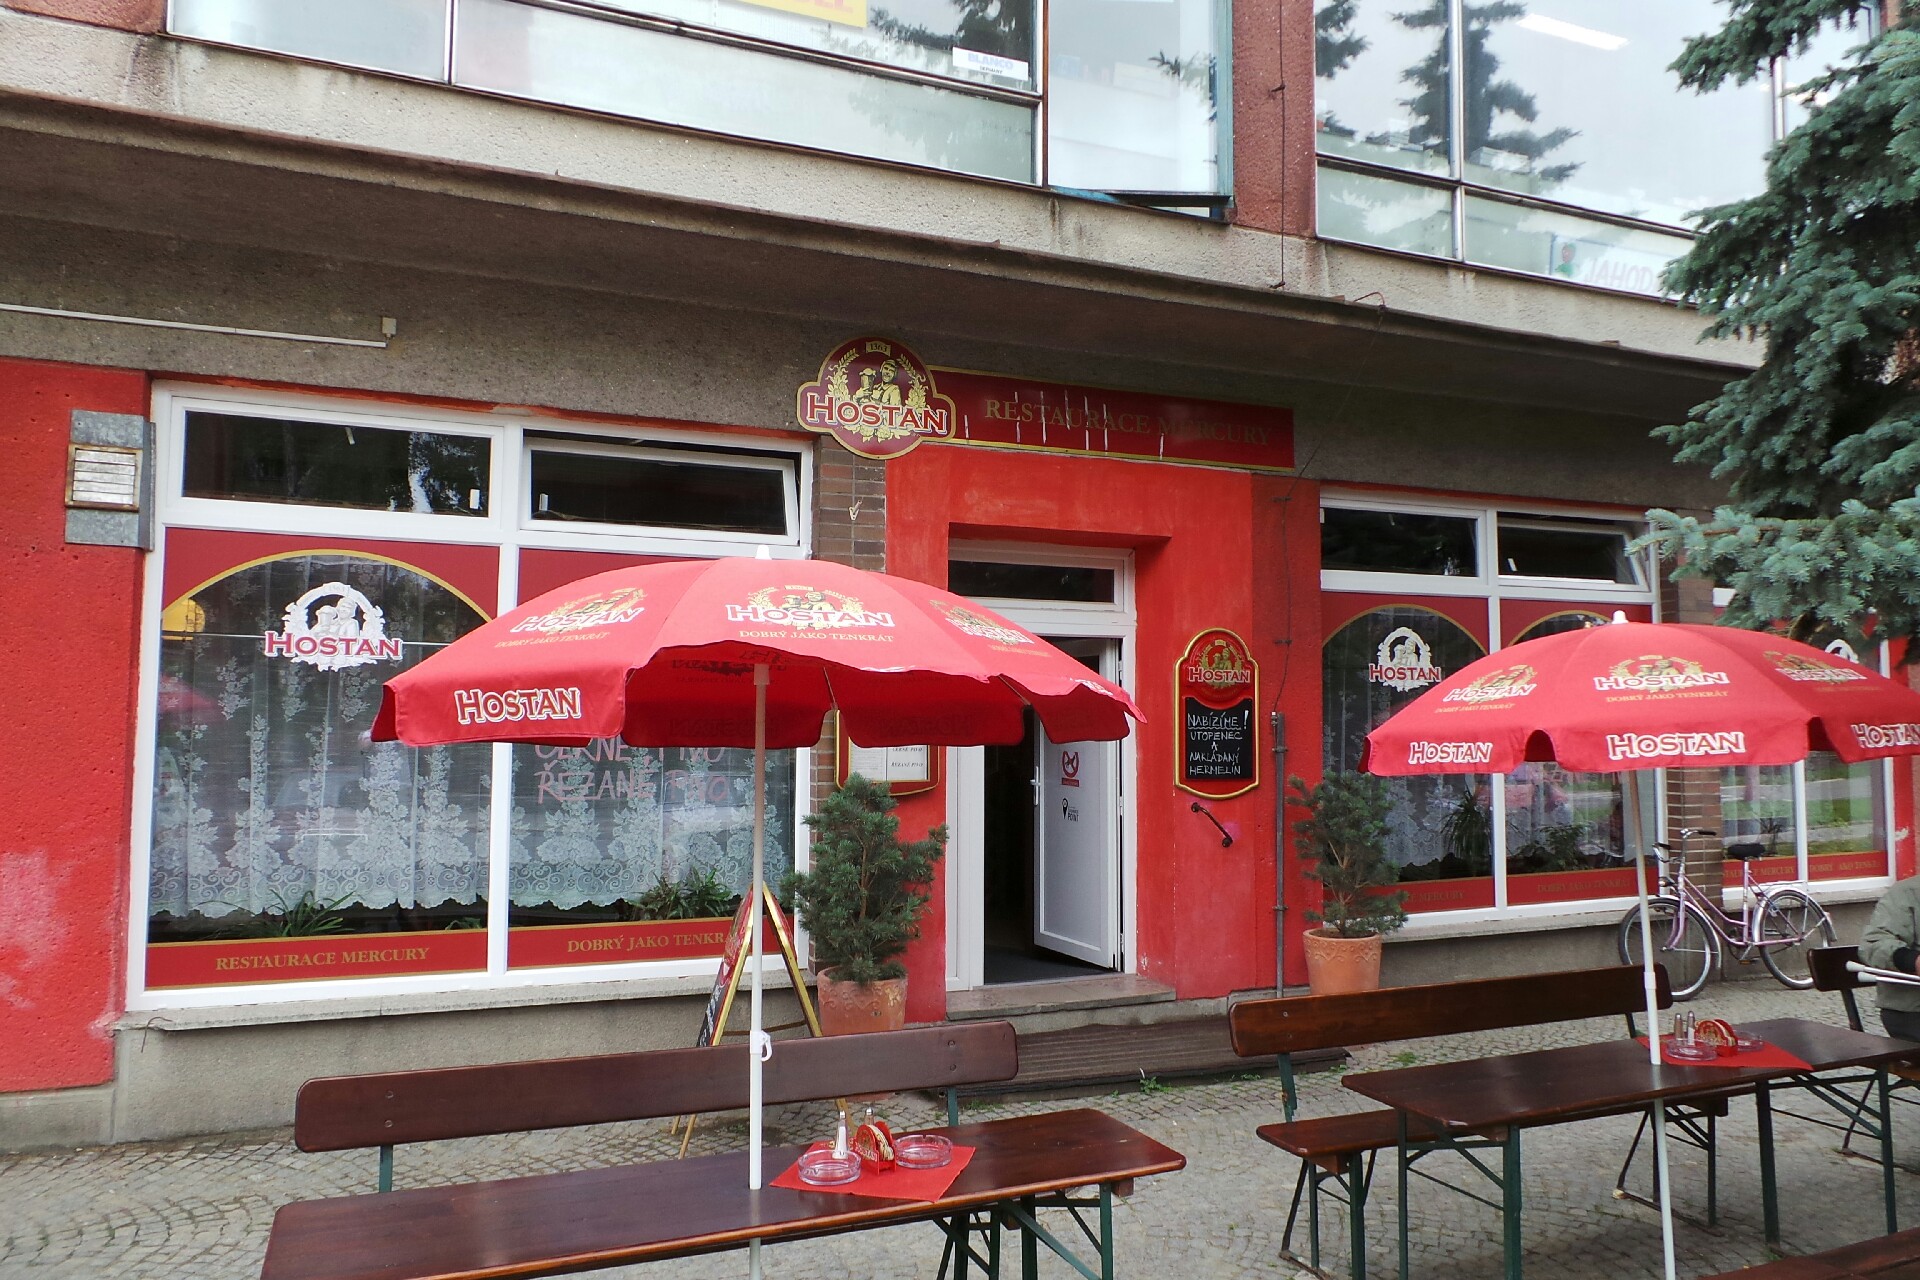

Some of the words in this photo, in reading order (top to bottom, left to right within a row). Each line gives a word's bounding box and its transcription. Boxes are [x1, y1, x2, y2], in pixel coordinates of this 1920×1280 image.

[1583, 257, 1659, 294] JAHOD
[807, 392, 948, 435] HOSTAN
[984, 399, 1150, 434] RESTAURACE
[1158, 415, 1271, 445] MERCURY
[510, 607, 645, 632] HOSTAN
[724, 604, 896, 627] HOSTAN
[264, 630, 403, 661] HOSTAN
[790, 631, 827, 640] JAKO
[828, 632, 894, 642] TENKRÁT
[1189, 666, 1250, 683] HOSTAN
[1369, 663, 1441, 682] HOSTAN
[1593, 671, 1730, 690] HOSTAN
[1443, 684, 1537, 702] HOSTAN
[454, 687, 581, 725] HOSTAN
[1190, 731, 1243, 741] UTOPENEC
[1606, 732, 1745, 760] HOSTAN
[1408, 741, 1493, 764] HOSTAN
[1189, 762, 1241, 776] HERMELÍN
[567, 934, 624, 952] DOBRÝ
[627, 935, 669, 951] JAKO
[673, 932, 725, 946] TENKR
[216, 952, 336, 970] RESTAURACE
[341, 947, 430, 964] MERCURY
